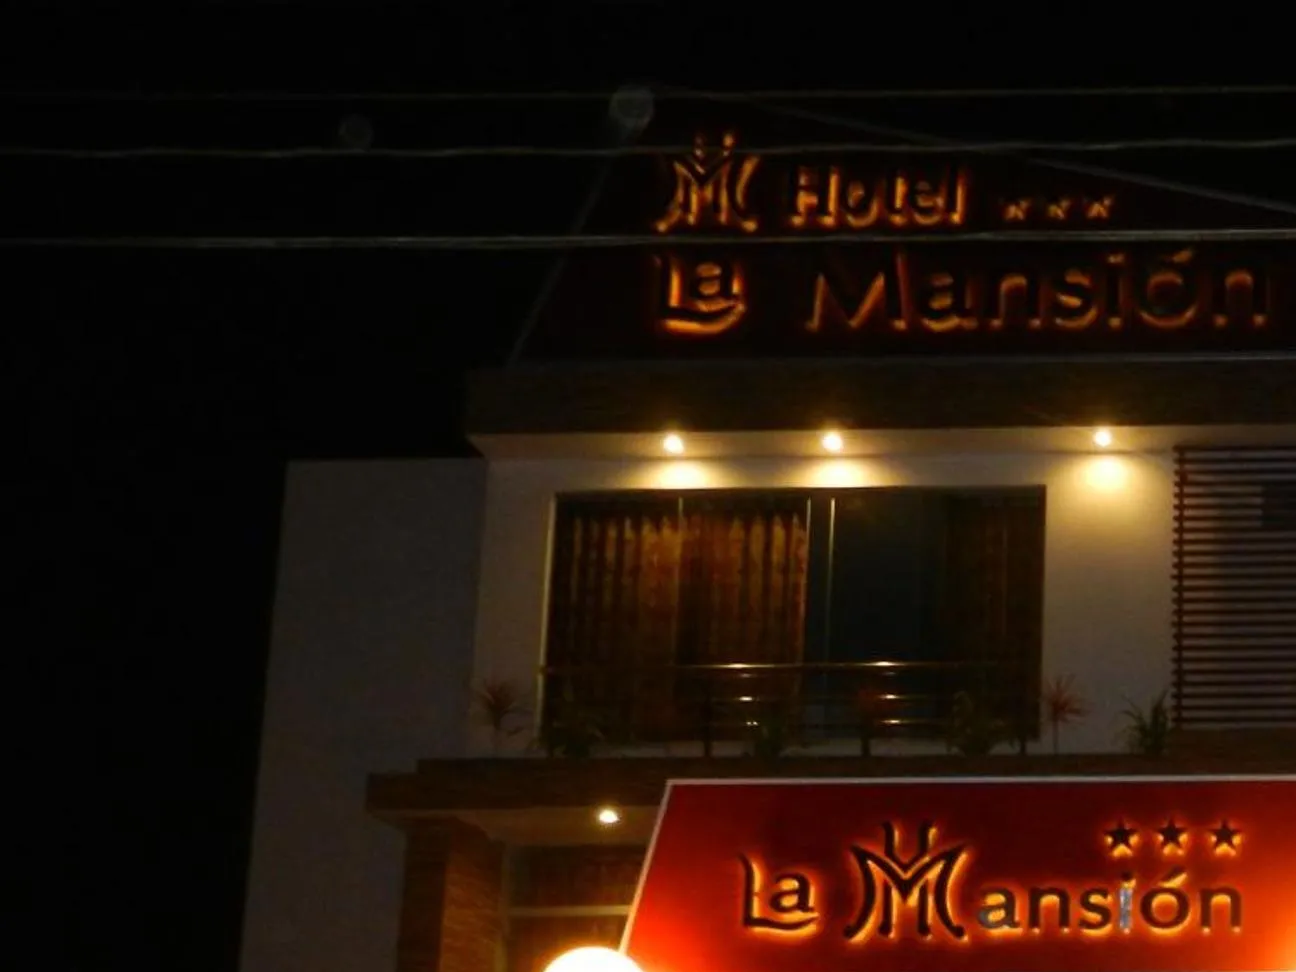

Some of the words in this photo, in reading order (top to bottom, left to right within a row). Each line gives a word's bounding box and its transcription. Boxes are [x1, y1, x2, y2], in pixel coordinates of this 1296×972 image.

[791, 164, 971, 228] Hotel
[803, 246, 1273, 332] Mansión
[738, 853, 820, 937] La
[842, 819, 1243, 944] Mansión
